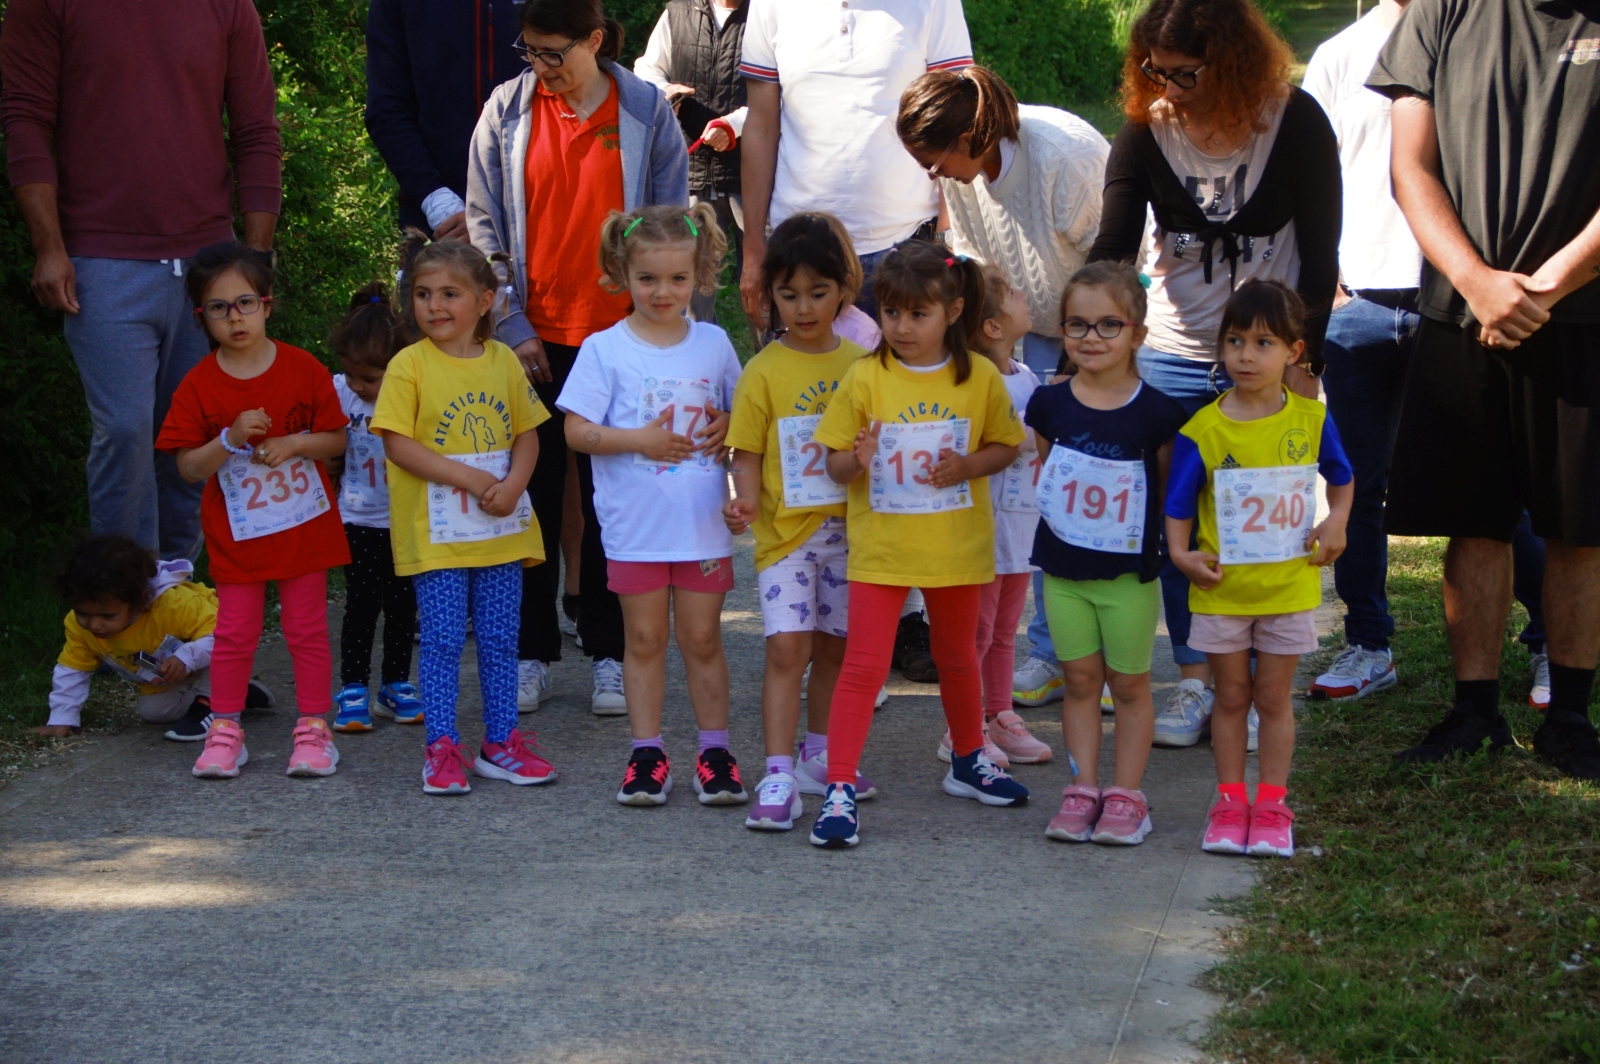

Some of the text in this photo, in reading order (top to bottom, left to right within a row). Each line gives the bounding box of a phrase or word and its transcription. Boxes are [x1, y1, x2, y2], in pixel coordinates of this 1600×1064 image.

[791, 380, 839, 416] ETICA
[892, 402, 957, 424] TICAI
[659, 403, 712, 441] 17
[1069, 432, 1123, 458] Love
[241, 460, 310, 511] 235
[887, 447, 952, 486] 13
[1061, 479, 1129, 523] 191
[1241, 493, 1305, 533] 240
